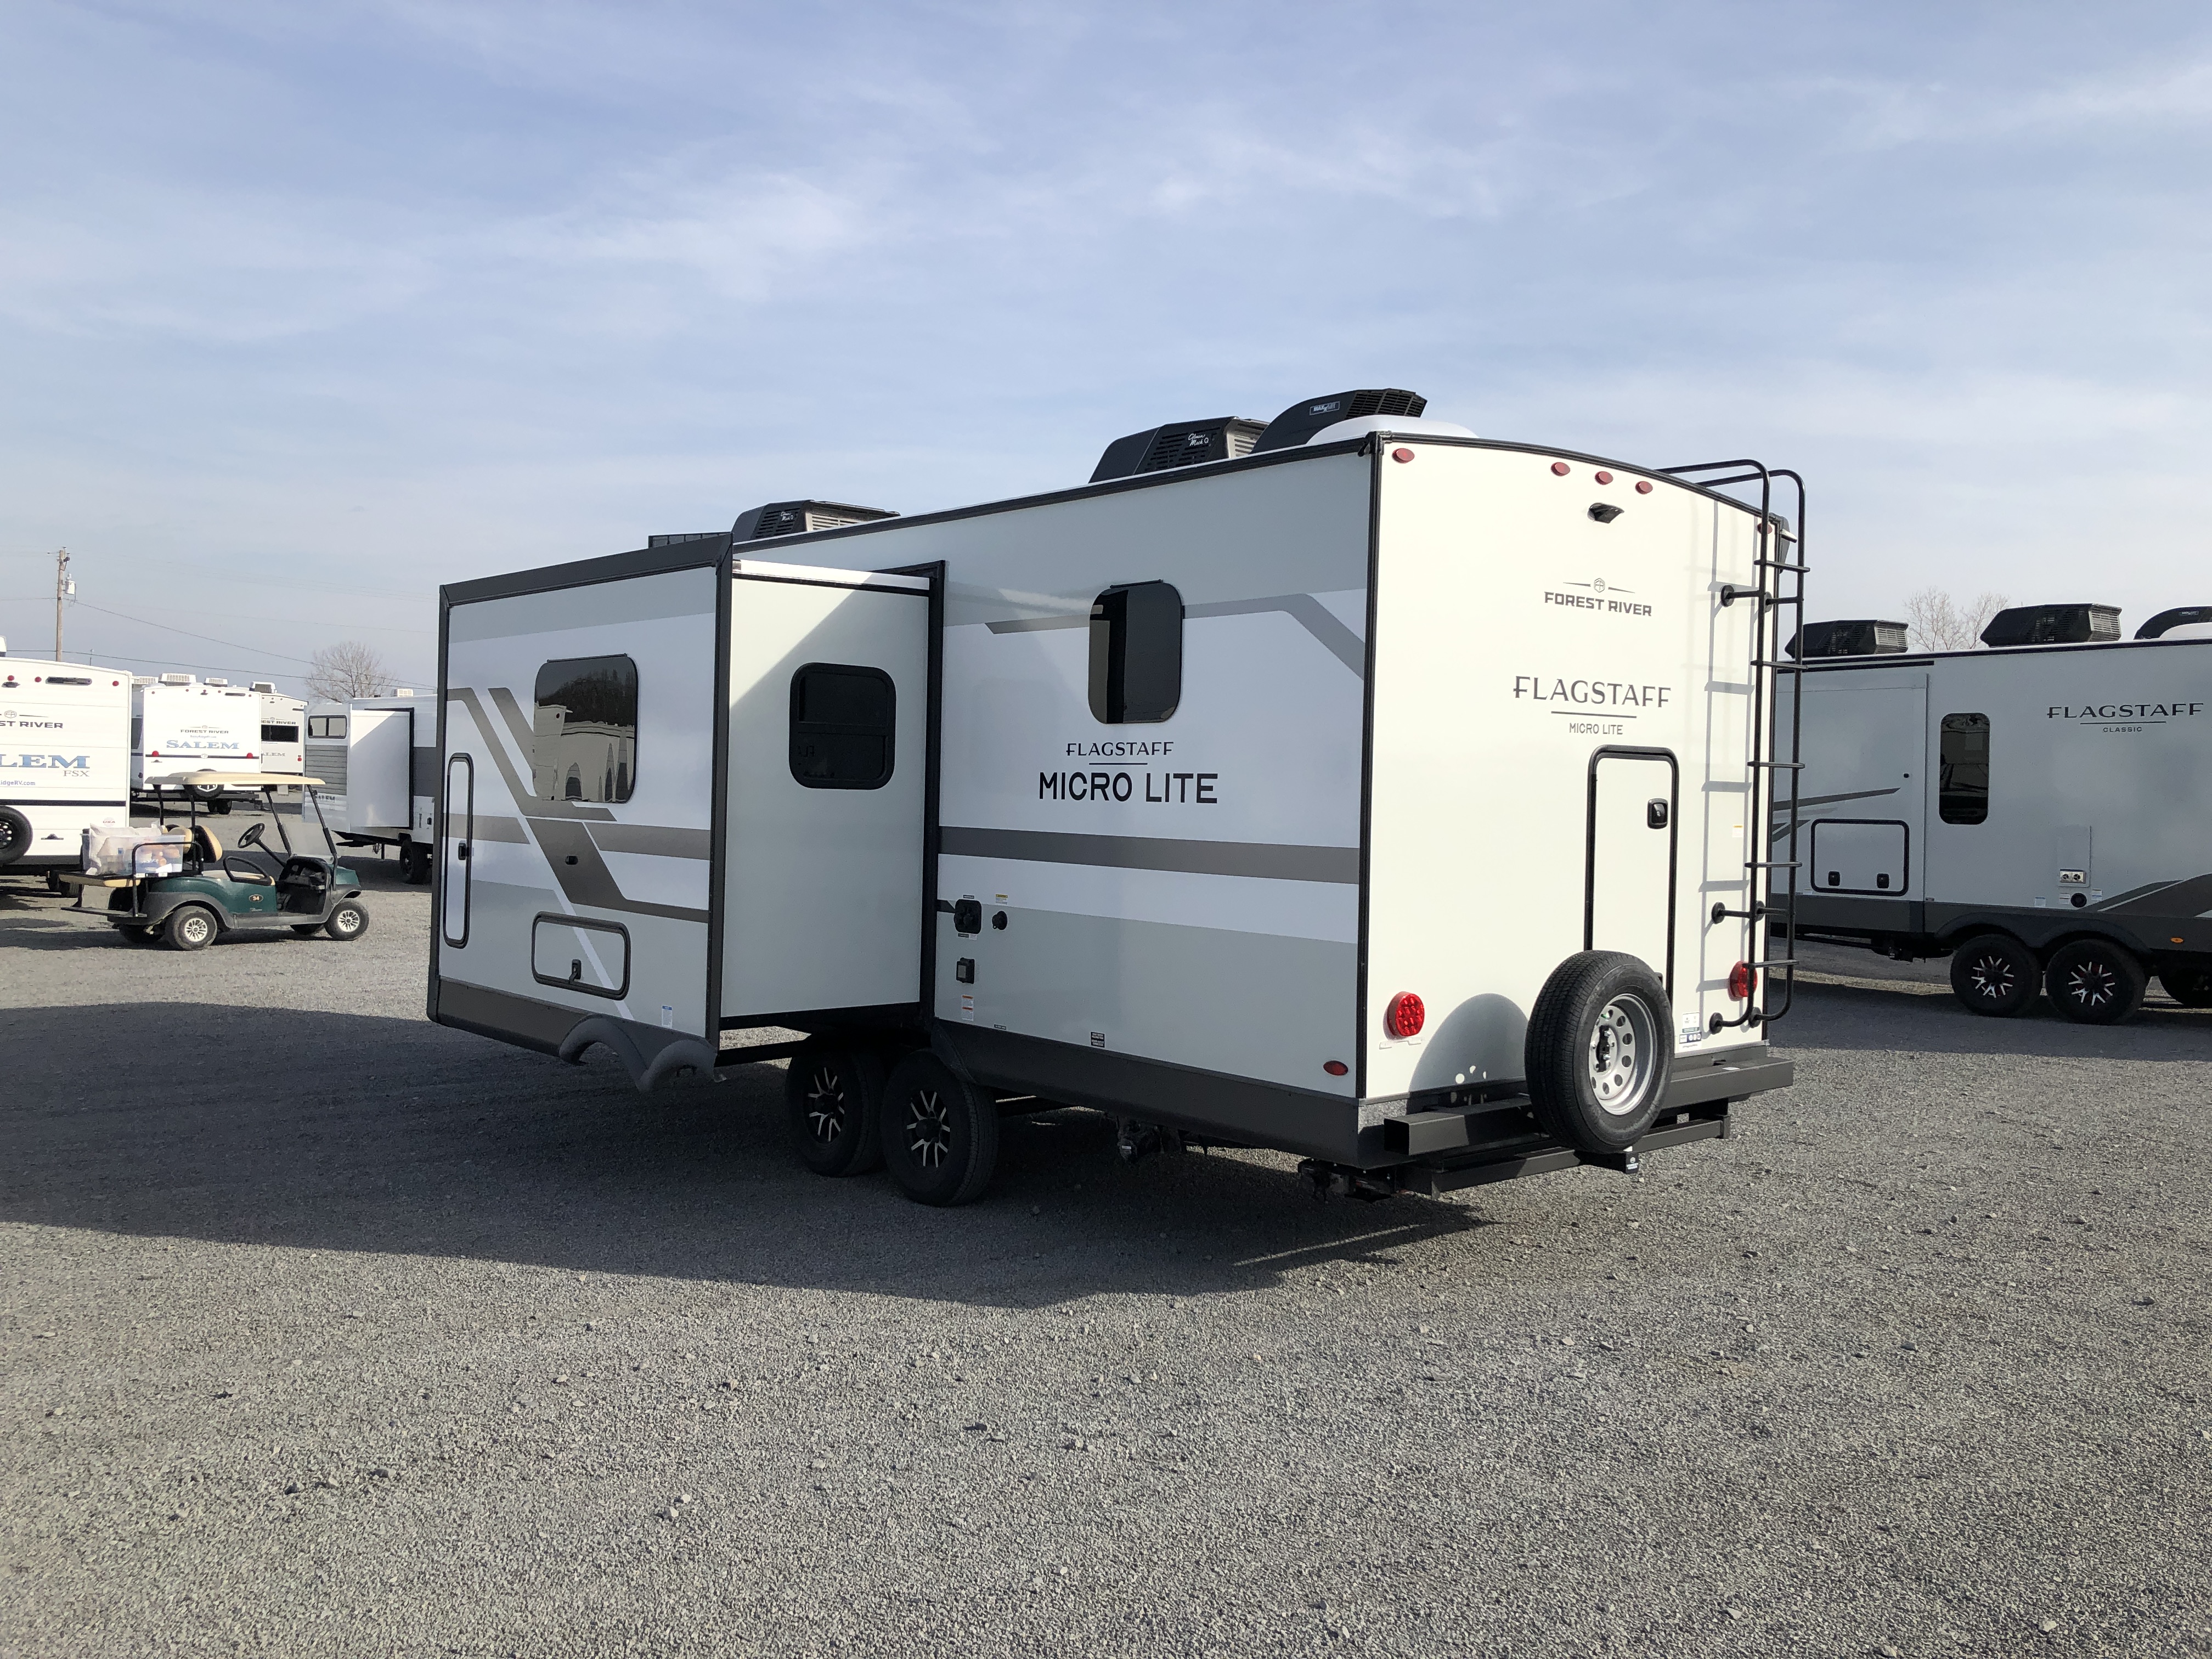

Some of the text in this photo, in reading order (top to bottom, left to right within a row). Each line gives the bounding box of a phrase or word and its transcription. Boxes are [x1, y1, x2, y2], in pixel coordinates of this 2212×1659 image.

[1544, 591, 1652, 617] FOREST RIVER
[1513, 675, 1671, 708] FLAGSTAFF
[2047, 703, 2204, 719] FLAGSTAFF
[19, 721, 64, 729] RIVER
[1569, 723, 1623, 735] MICRO LITE
[166, 740, 240, 749] SALEM
[1066, 741, 1174, 757] FLAGSTAFF
[1039, 771, 1218, 804] MICRO LITE
